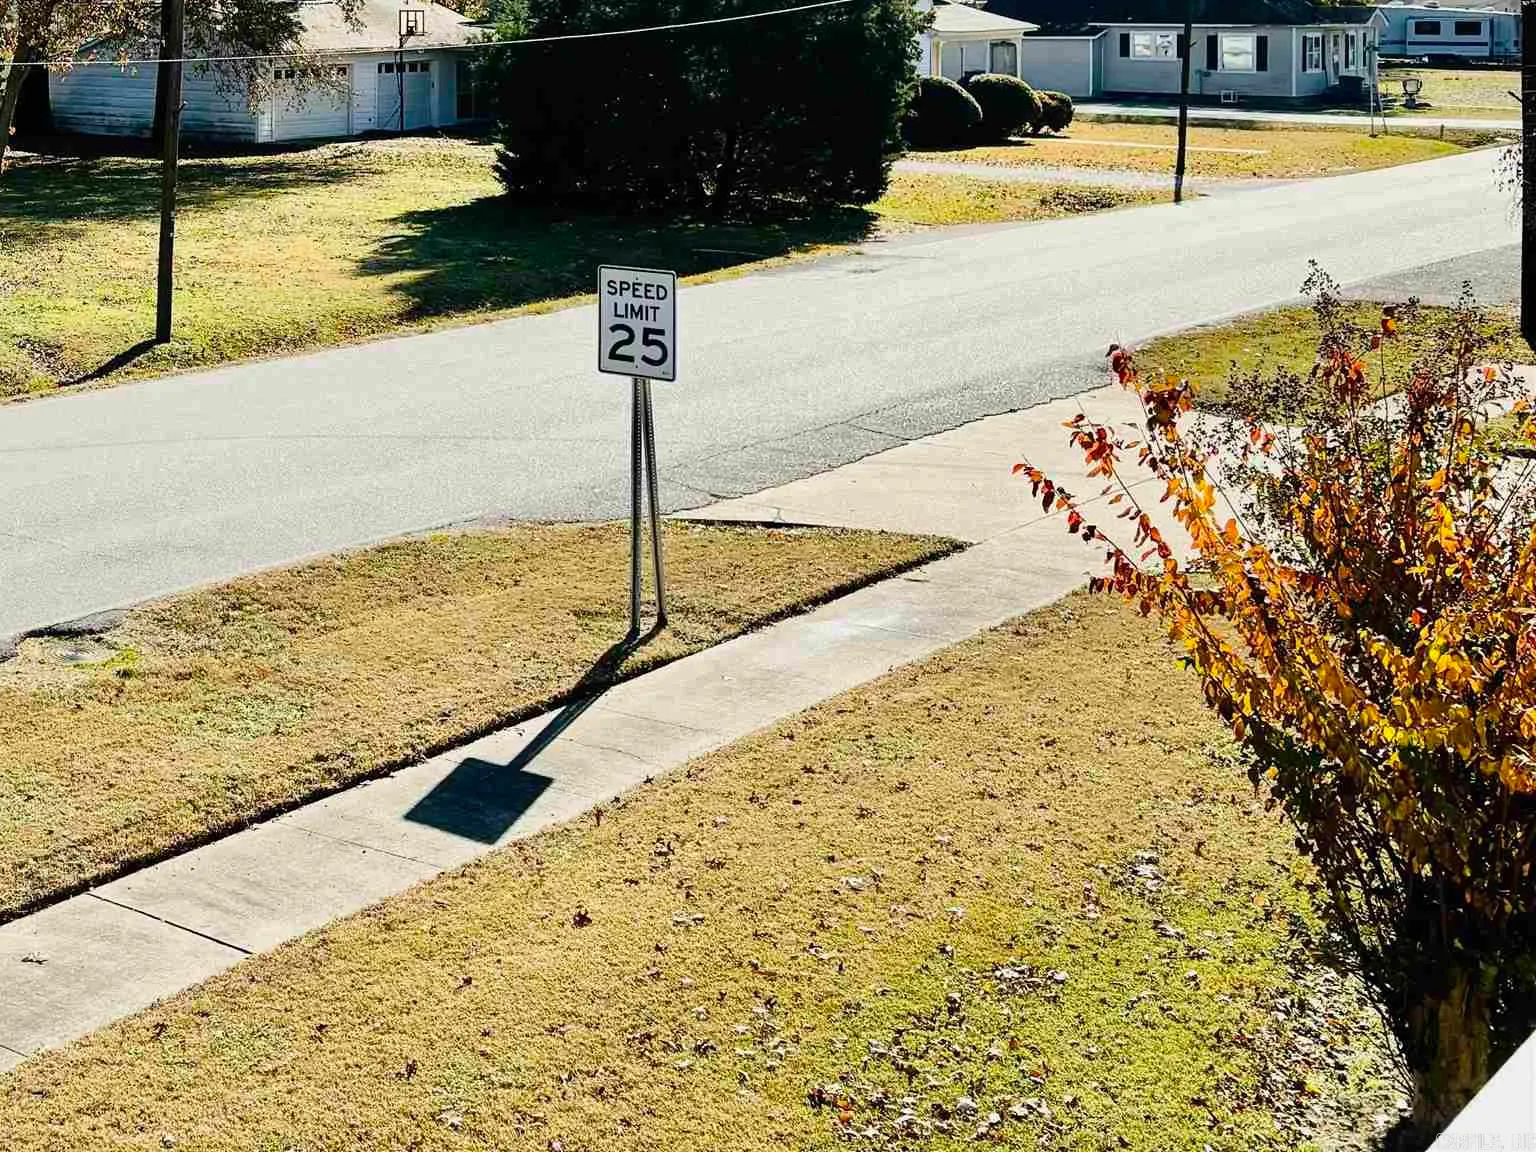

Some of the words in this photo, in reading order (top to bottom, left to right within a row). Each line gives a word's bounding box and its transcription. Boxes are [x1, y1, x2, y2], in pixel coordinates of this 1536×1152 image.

[607, 280, 668, 300] SPEED
[613, 302, 660, 322] LIMIT
[607, 323, 668, 366] 25
